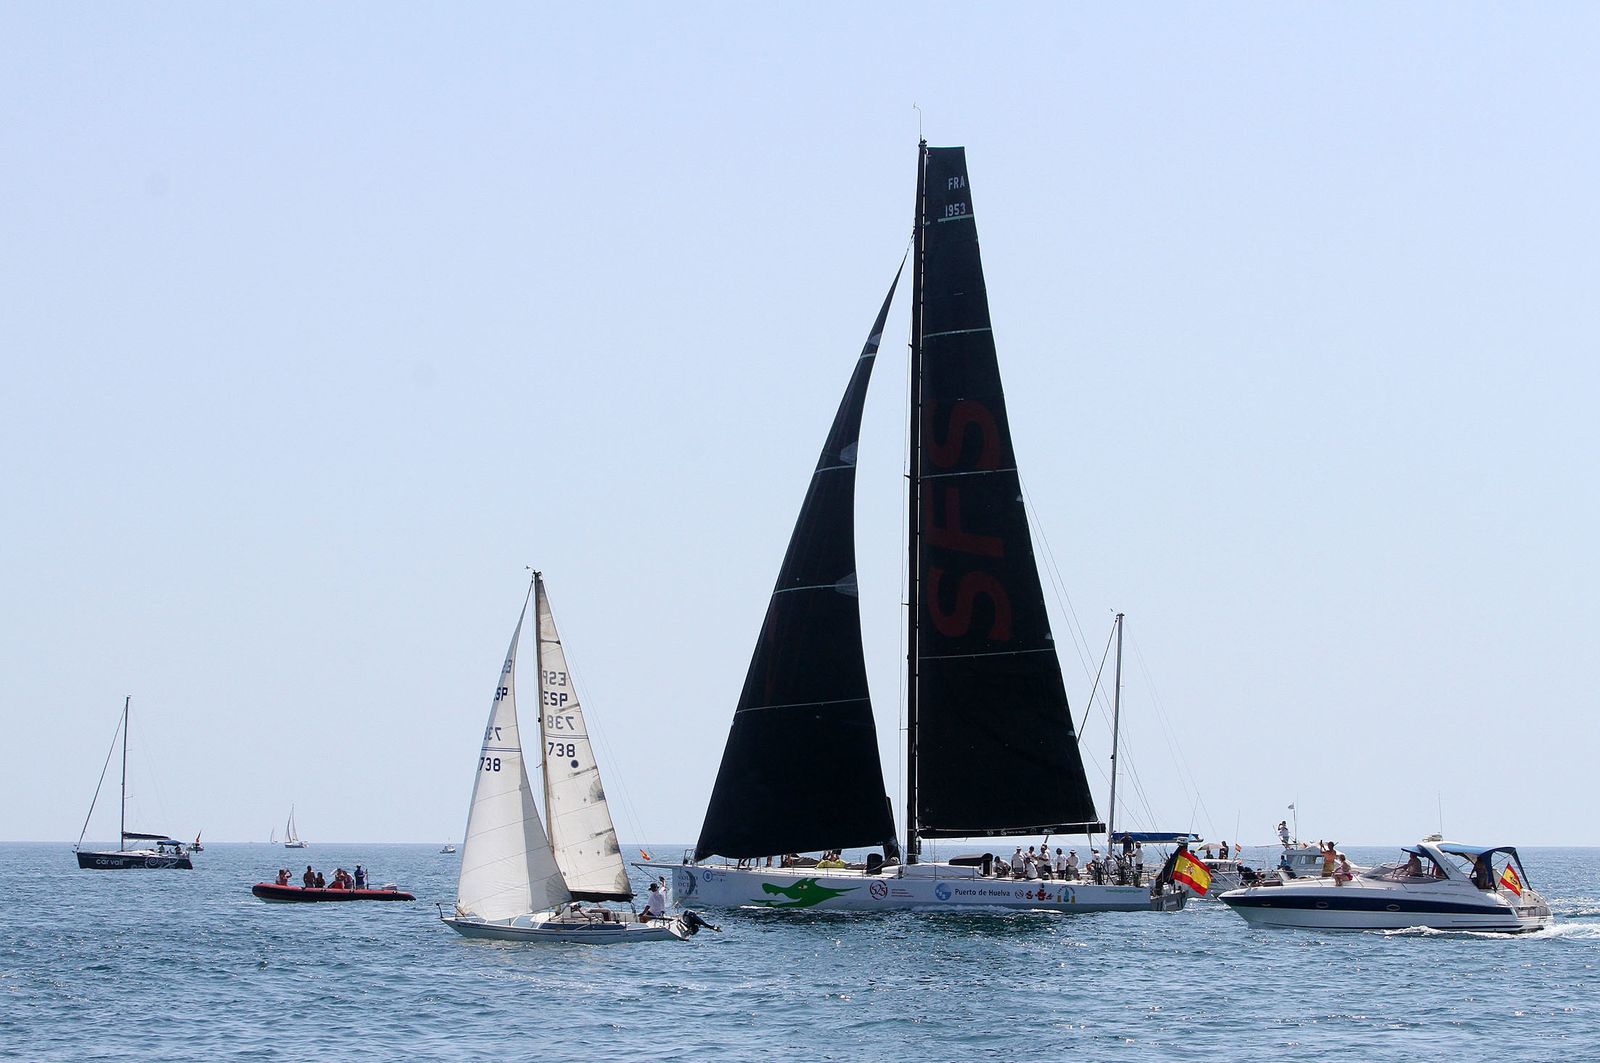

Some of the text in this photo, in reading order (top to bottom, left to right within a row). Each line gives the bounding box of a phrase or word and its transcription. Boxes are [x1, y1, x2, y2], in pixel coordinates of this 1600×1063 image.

[947, 175, 966, 191] FRA
[945, 202, 966, 217] 1953
[924, 399, 1014, 641] SFS
[494, 687, 508, 702] SP
[543, 691, 568, 707] ESP
[548, 742, 576, 758] 738
[479, 757, 501, 772] 738
[954, 888, 1011, 897] Puerto de Huelva
